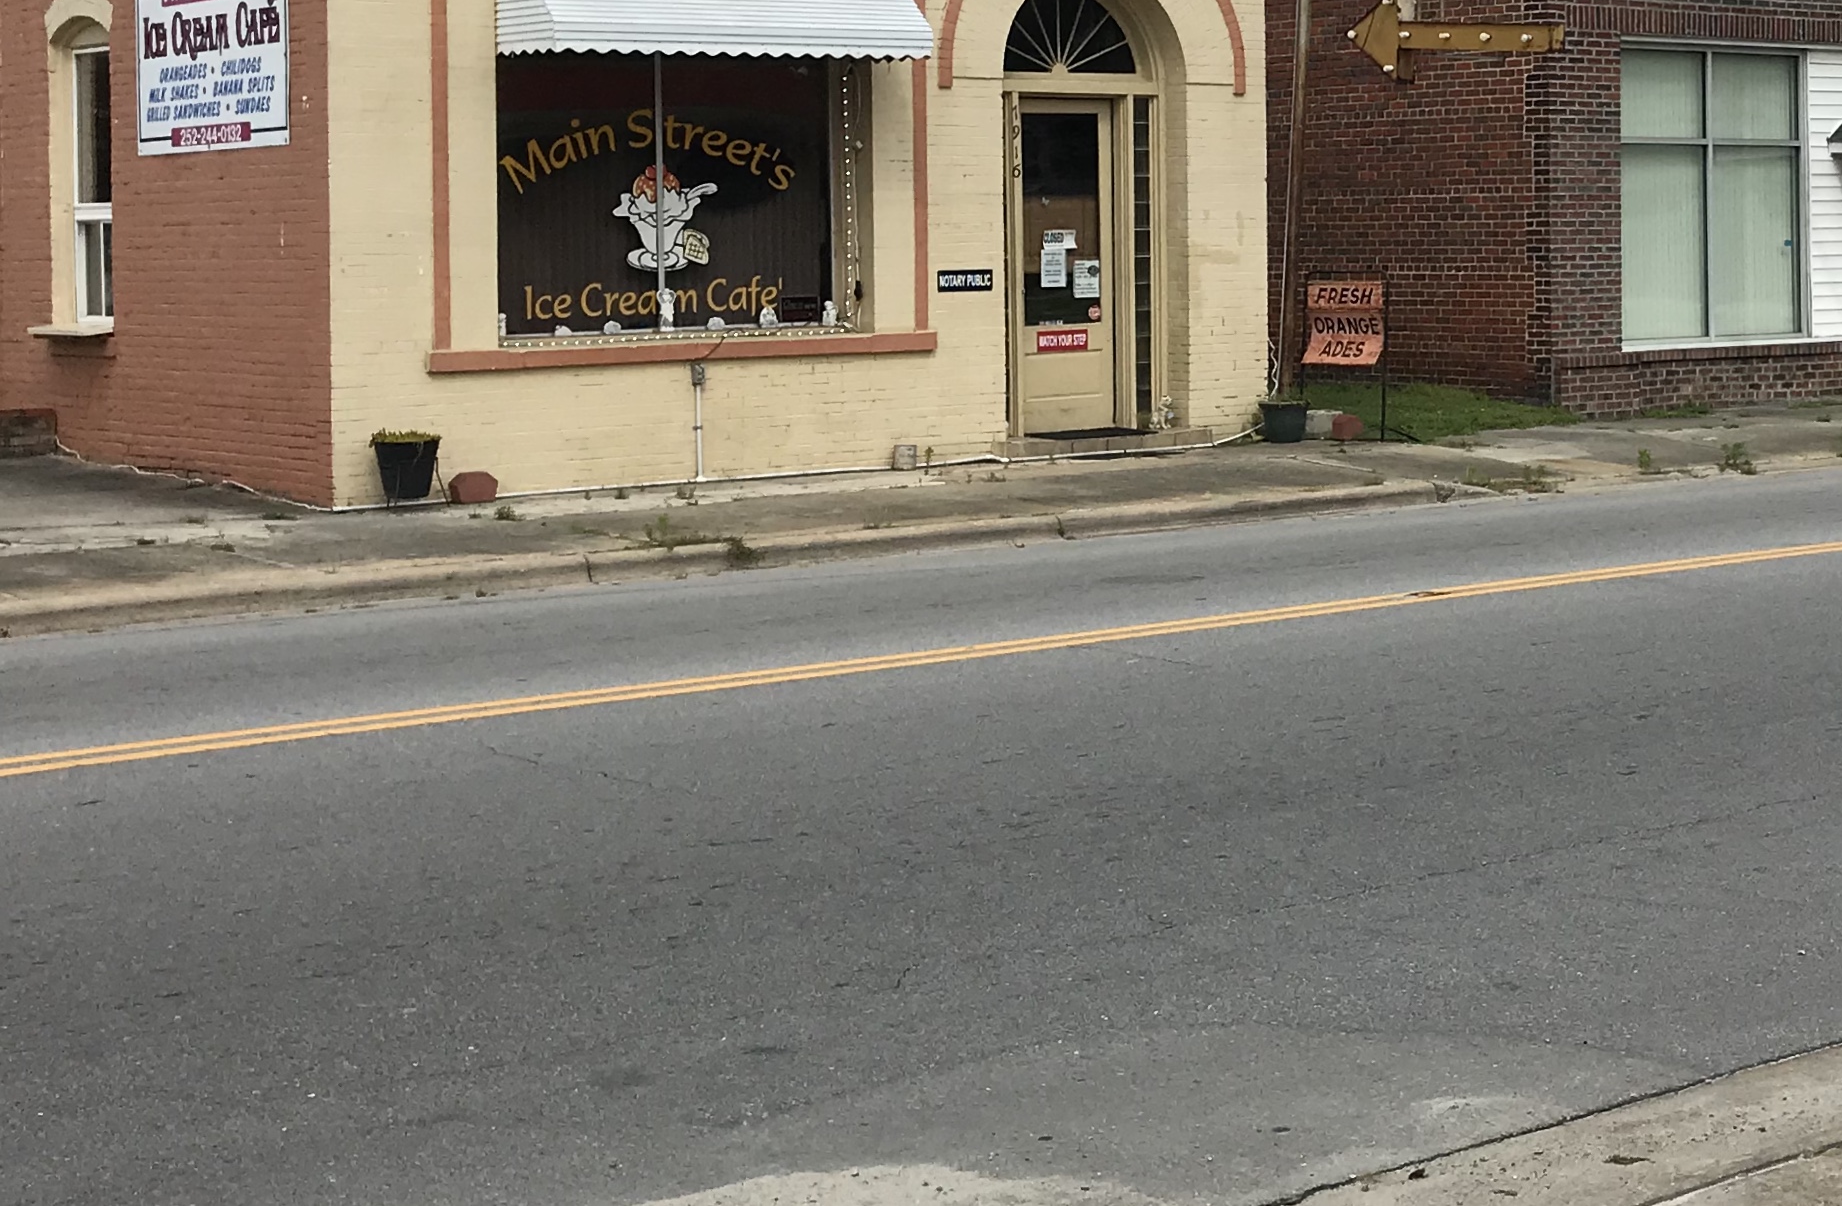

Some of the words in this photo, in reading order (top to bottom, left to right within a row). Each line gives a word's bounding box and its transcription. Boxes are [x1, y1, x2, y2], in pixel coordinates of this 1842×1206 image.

[143, 16, 168, 60] ICE
[160, 63, 207, 84] ORANGEADES
[221, 56, 262, 76] CHILIDOGS
[148, 87, 167, 104] MILK
[170, 84, 199, 102] SHAKES
[213, 78, 244, 98] BANANA
[247, 75, 275, 93] SPLITS
[146, 106, 170, 122] GRILLED
[173, 100, 222, 120] SANDWICHES
[235, 96, 271, 115] SUNDAES
[180, 124, 242, 146] 252-244-0132
[499, 118, 617, 195] Main
[626, 108, 797, 192] Street's
[1044, 232, 1064, 244] CLOSED
[939, 274, 966, 288] NOTARY
[966, 274, 991, 287] PUBLIC
[524, 285, 572, 320] Ice
[580, 282, 697, 318] Cream
[1314, 288, 1374, 304] FRESH
[1314, 316, 1380, 336] ORANGE
[1039, 335, 1058, 347] WATCH
[1058, 334, 1072, 346] YOUR
[1074, 334, 1086, 346] STEP
[1319, 340, 1366, 358] ADES
